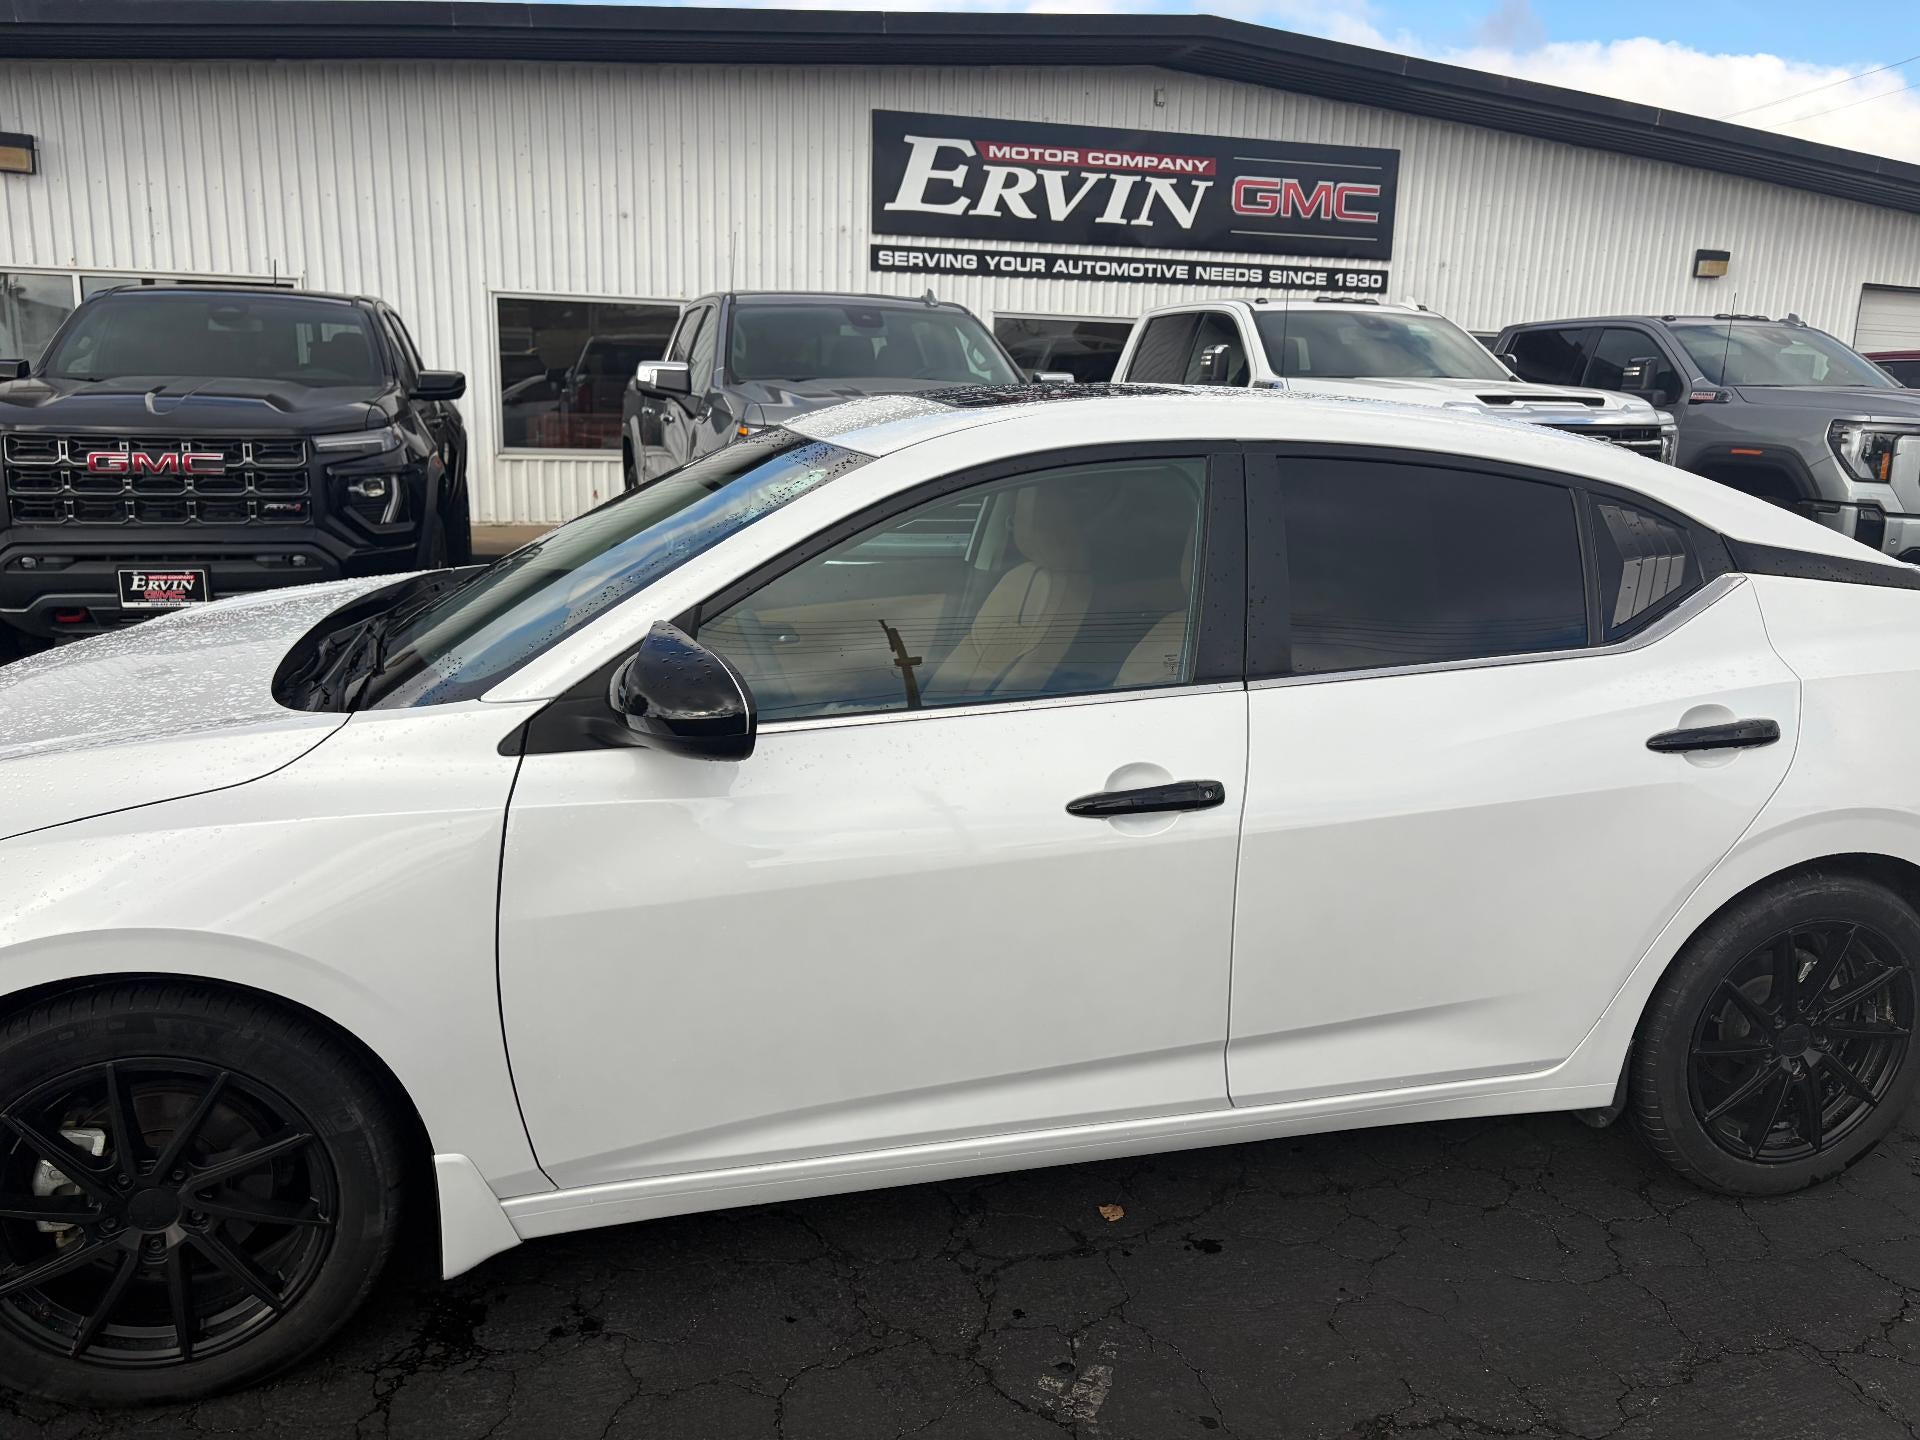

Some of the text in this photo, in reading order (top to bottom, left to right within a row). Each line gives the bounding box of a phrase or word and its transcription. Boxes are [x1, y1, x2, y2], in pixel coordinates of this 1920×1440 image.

[988, 145, 1210, 173] MOTOR COMPANY
[884, 134, 1214, 229] ERVIN
[1231, 175, 1382, 223] GMC
[877, 250, 1383, 289] SERVING YOUR AUTOMOTIVE NEEDS SINCE 1930
[87, 451, 225, 474] GMC
[130, 575, 195, 591] ERVIN
[144, 590, 186, 599] GMC
